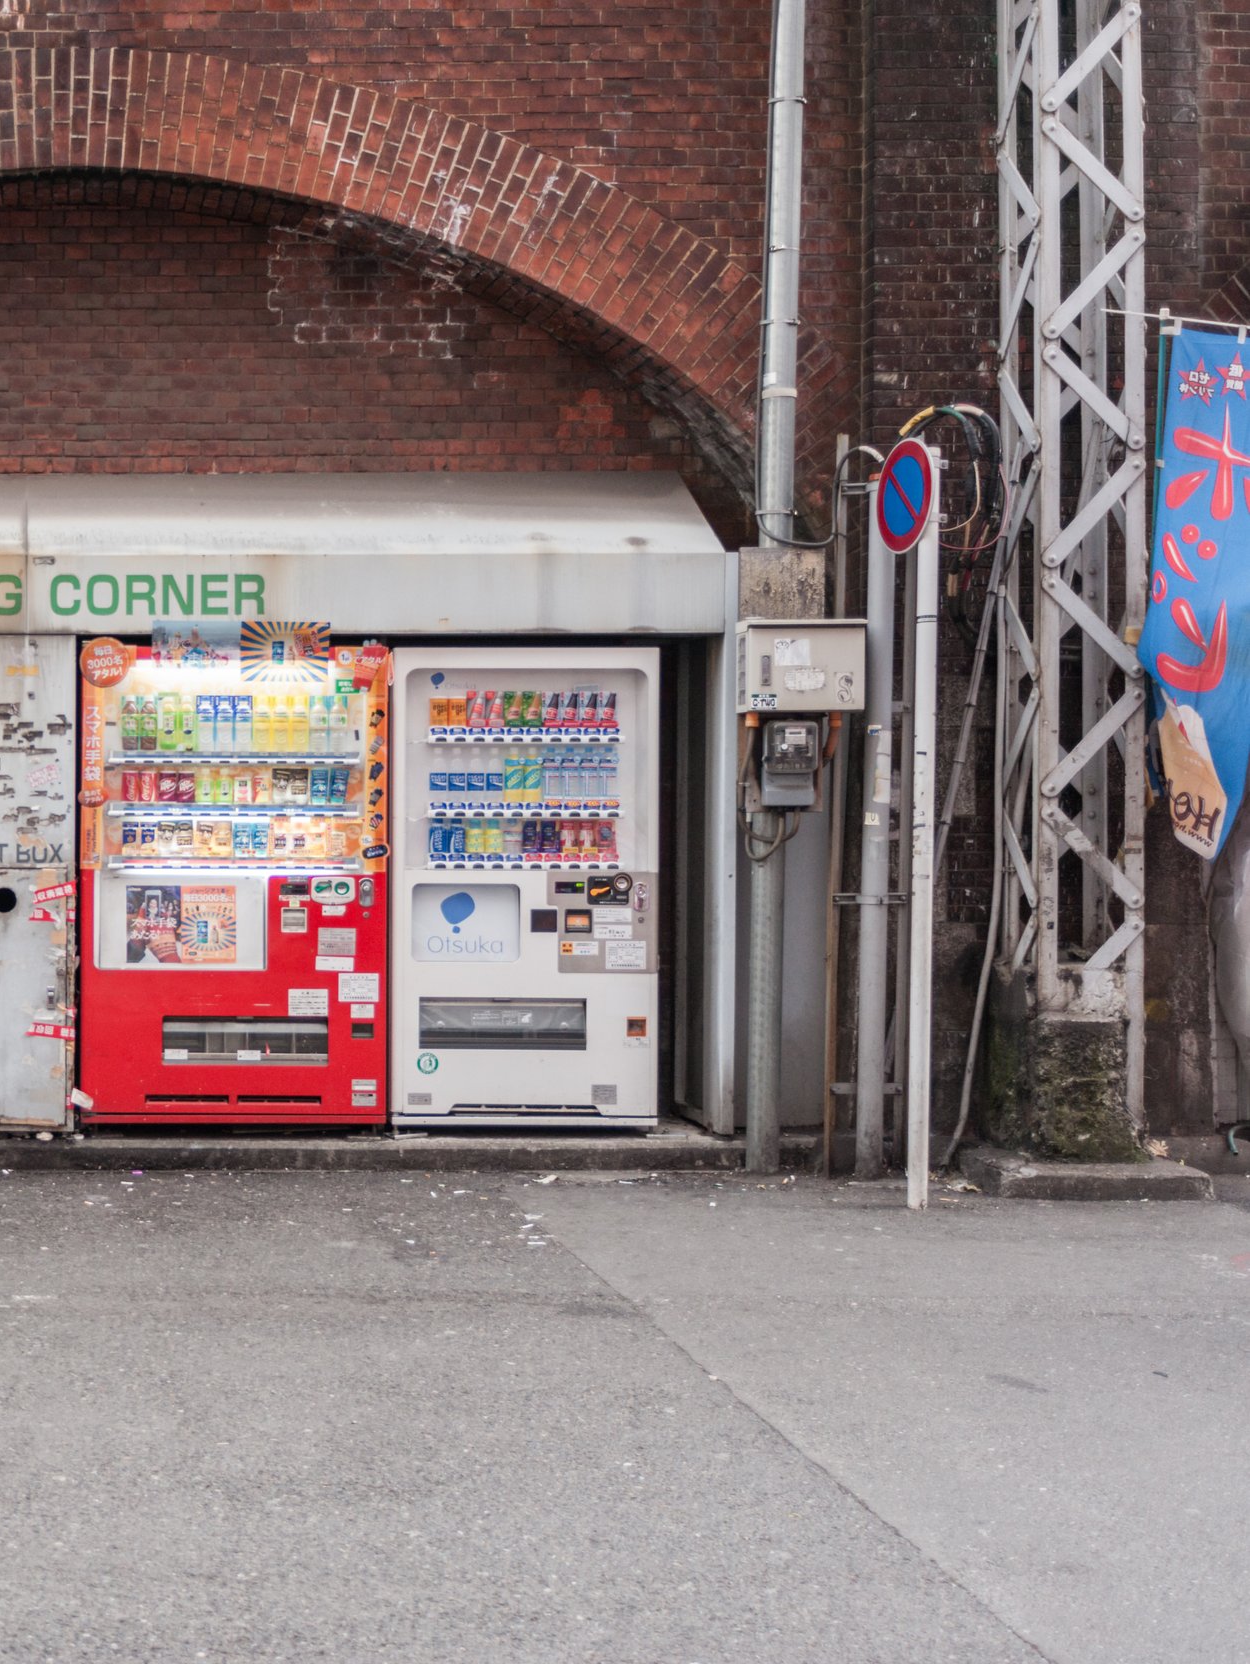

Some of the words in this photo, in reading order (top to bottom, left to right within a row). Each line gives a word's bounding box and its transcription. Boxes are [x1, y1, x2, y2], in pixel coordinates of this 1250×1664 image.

[51, 573, 266, 616] CORNER
[93, 645, 113, 656] 毎日
[87, 656, 124, 670] 3000名
[84, 706, 102, 782] スマホ手袋
[427, 935, 503, 954] Otsuka
